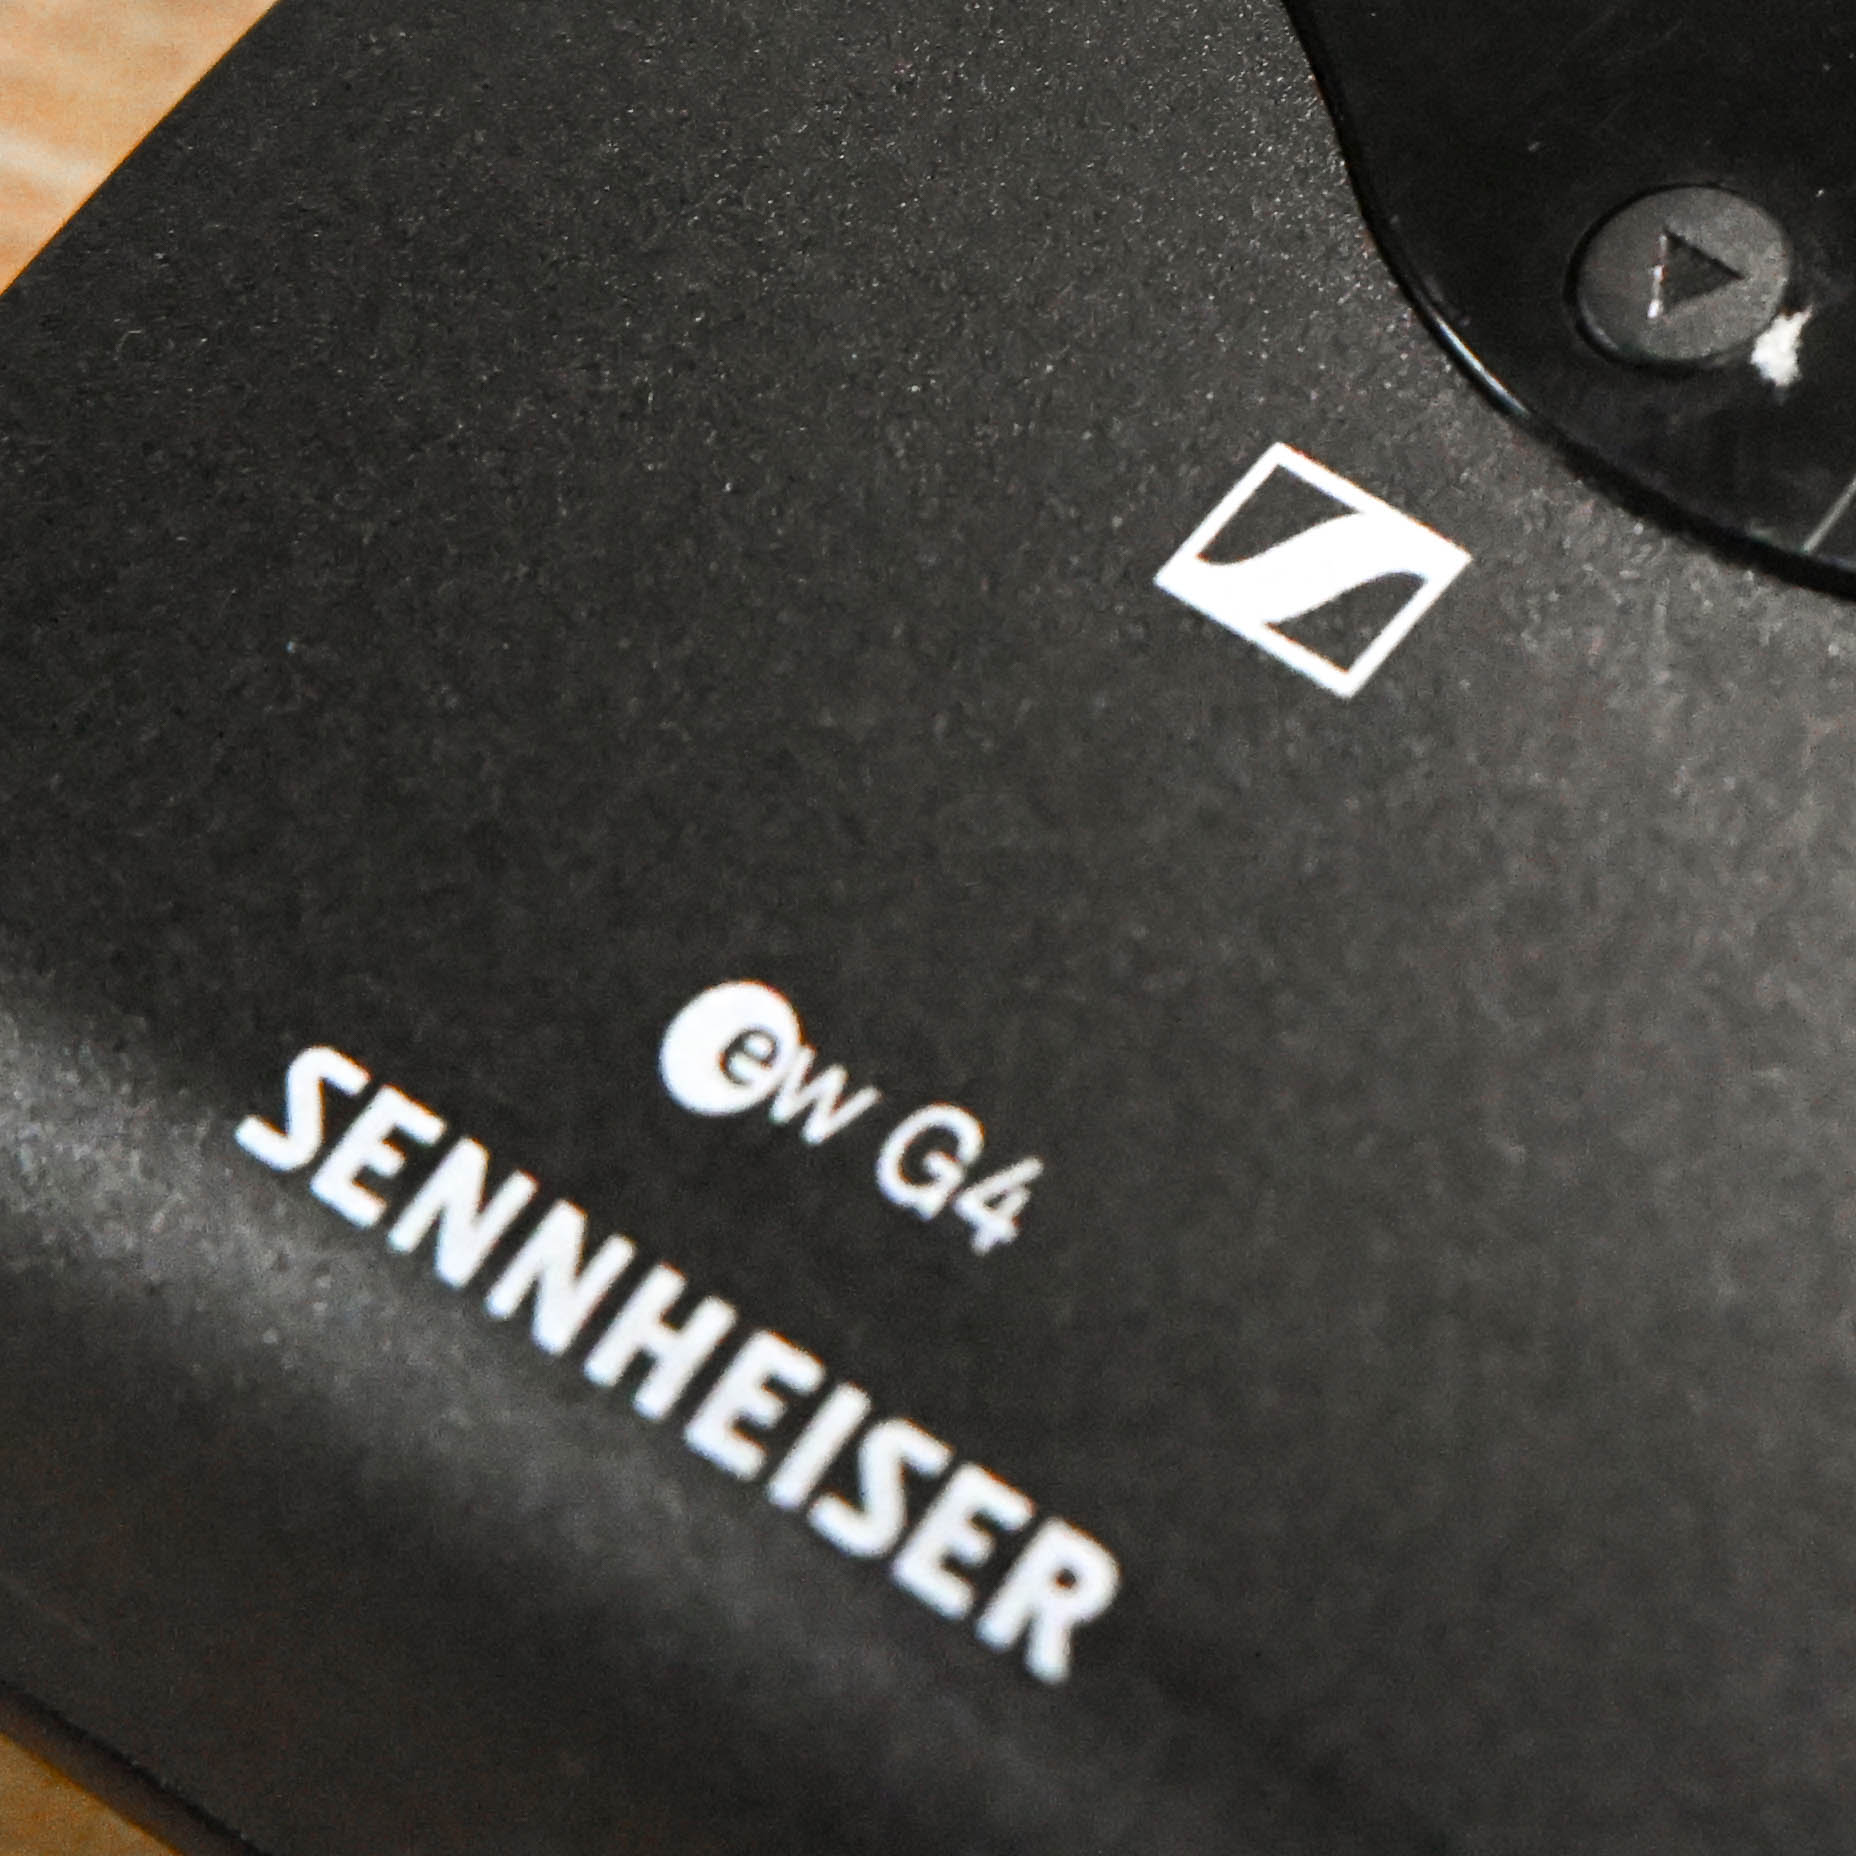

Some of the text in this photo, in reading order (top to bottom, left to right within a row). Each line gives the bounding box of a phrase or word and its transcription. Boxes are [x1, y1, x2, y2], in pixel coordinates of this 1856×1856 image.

[661, 981, 1045, 1255] ew G4
[233, 1045, 1120, 1683] SENNHEISER
